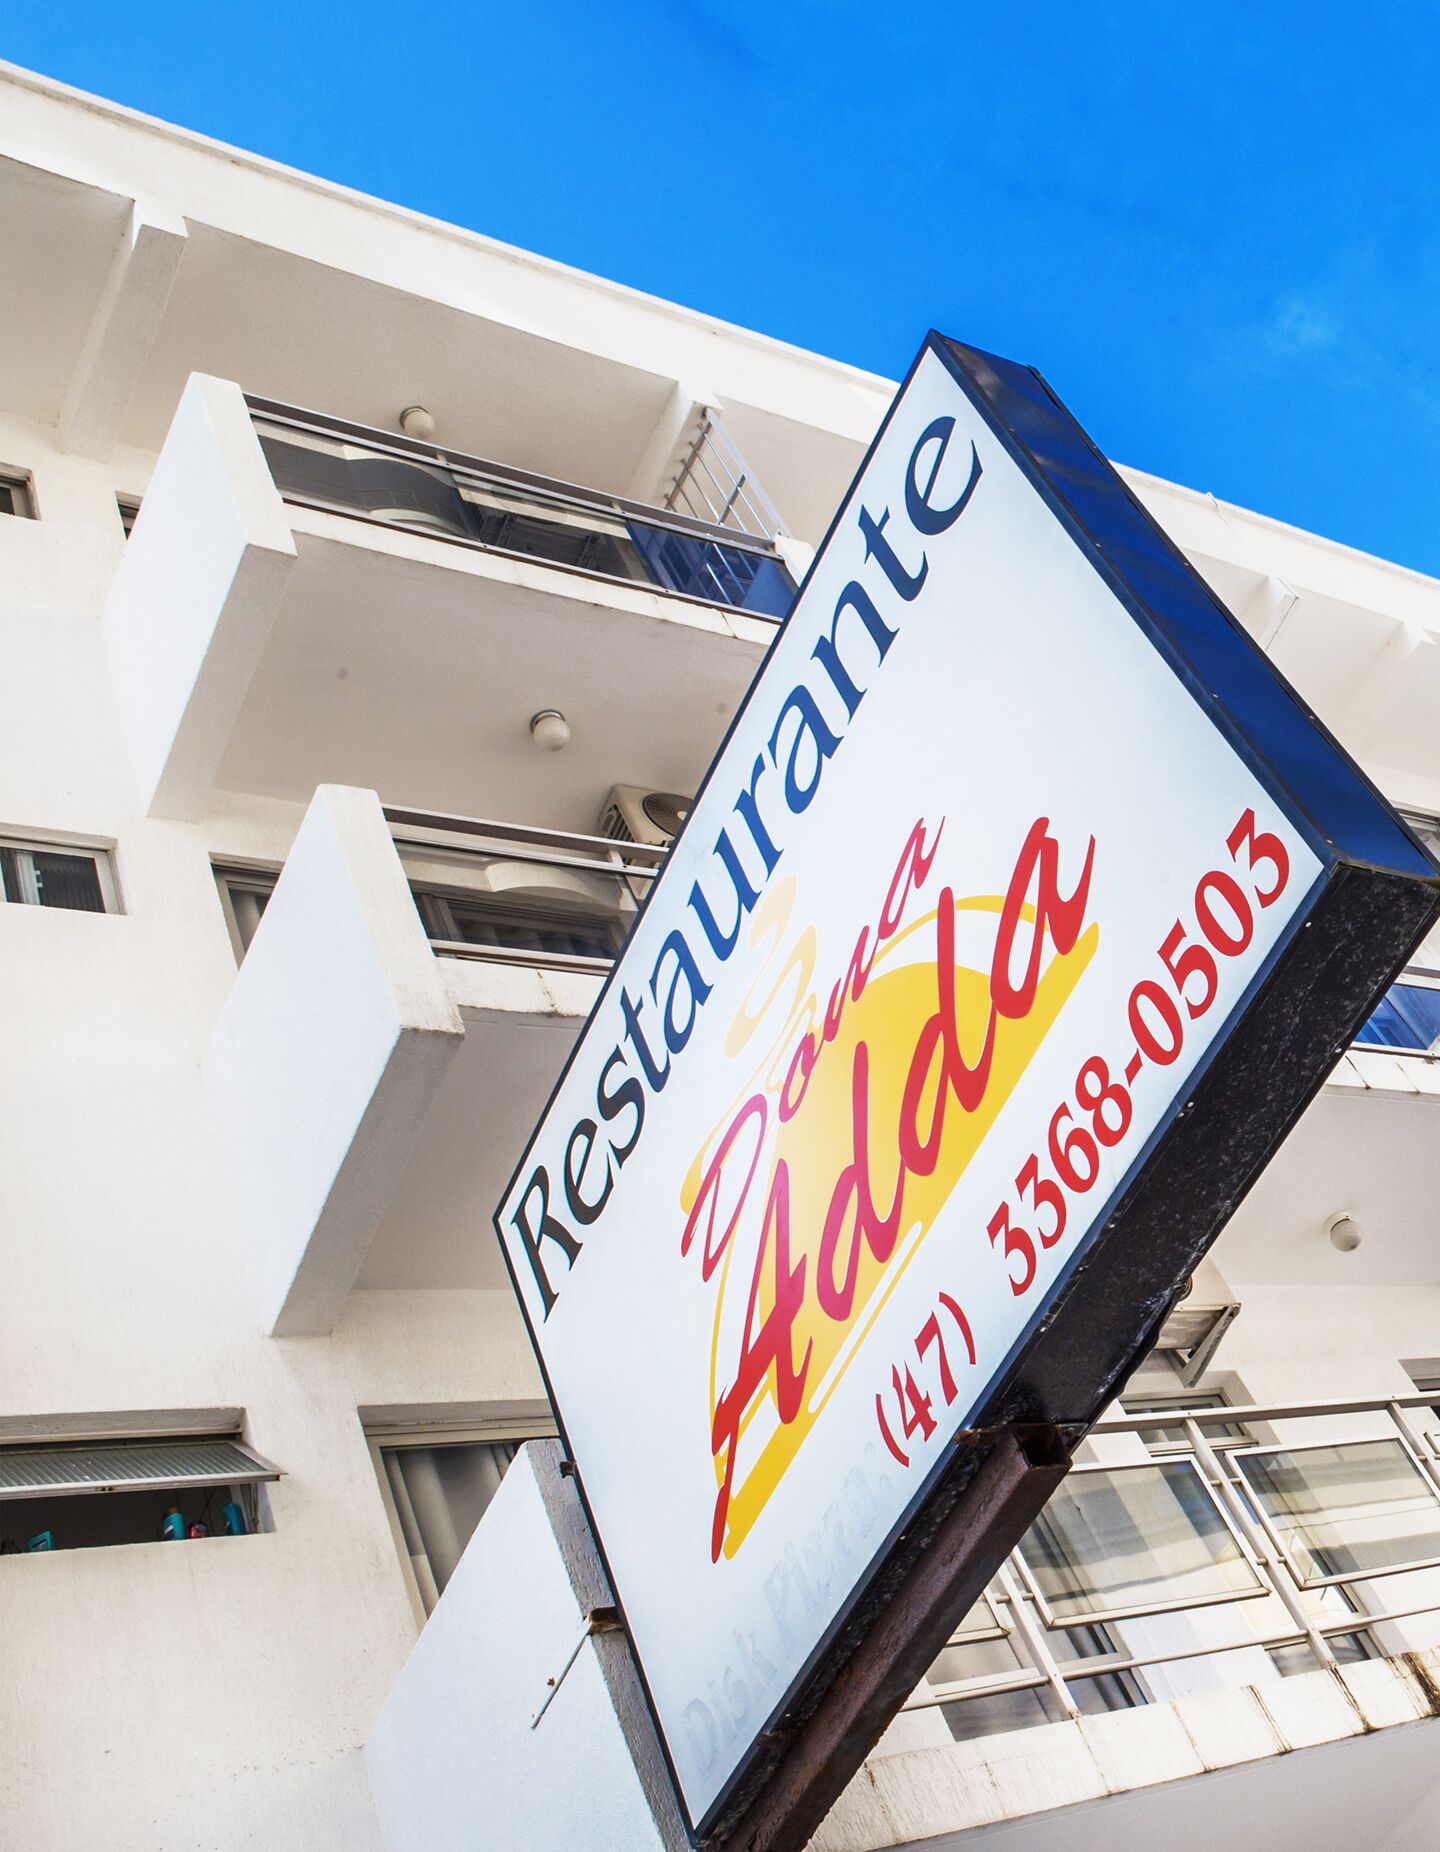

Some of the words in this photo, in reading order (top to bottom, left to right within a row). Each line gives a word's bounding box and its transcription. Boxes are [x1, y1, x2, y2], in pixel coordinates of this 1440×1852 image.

[511, 415, 984, 1322] Restaurante
[681, 816, 946, 1283] Dona
[711, 816, 1097, 1564] Adda
[875, 1291, 976, 1468] (47)
[986, 807, 1291, 1296] 3368-0503
